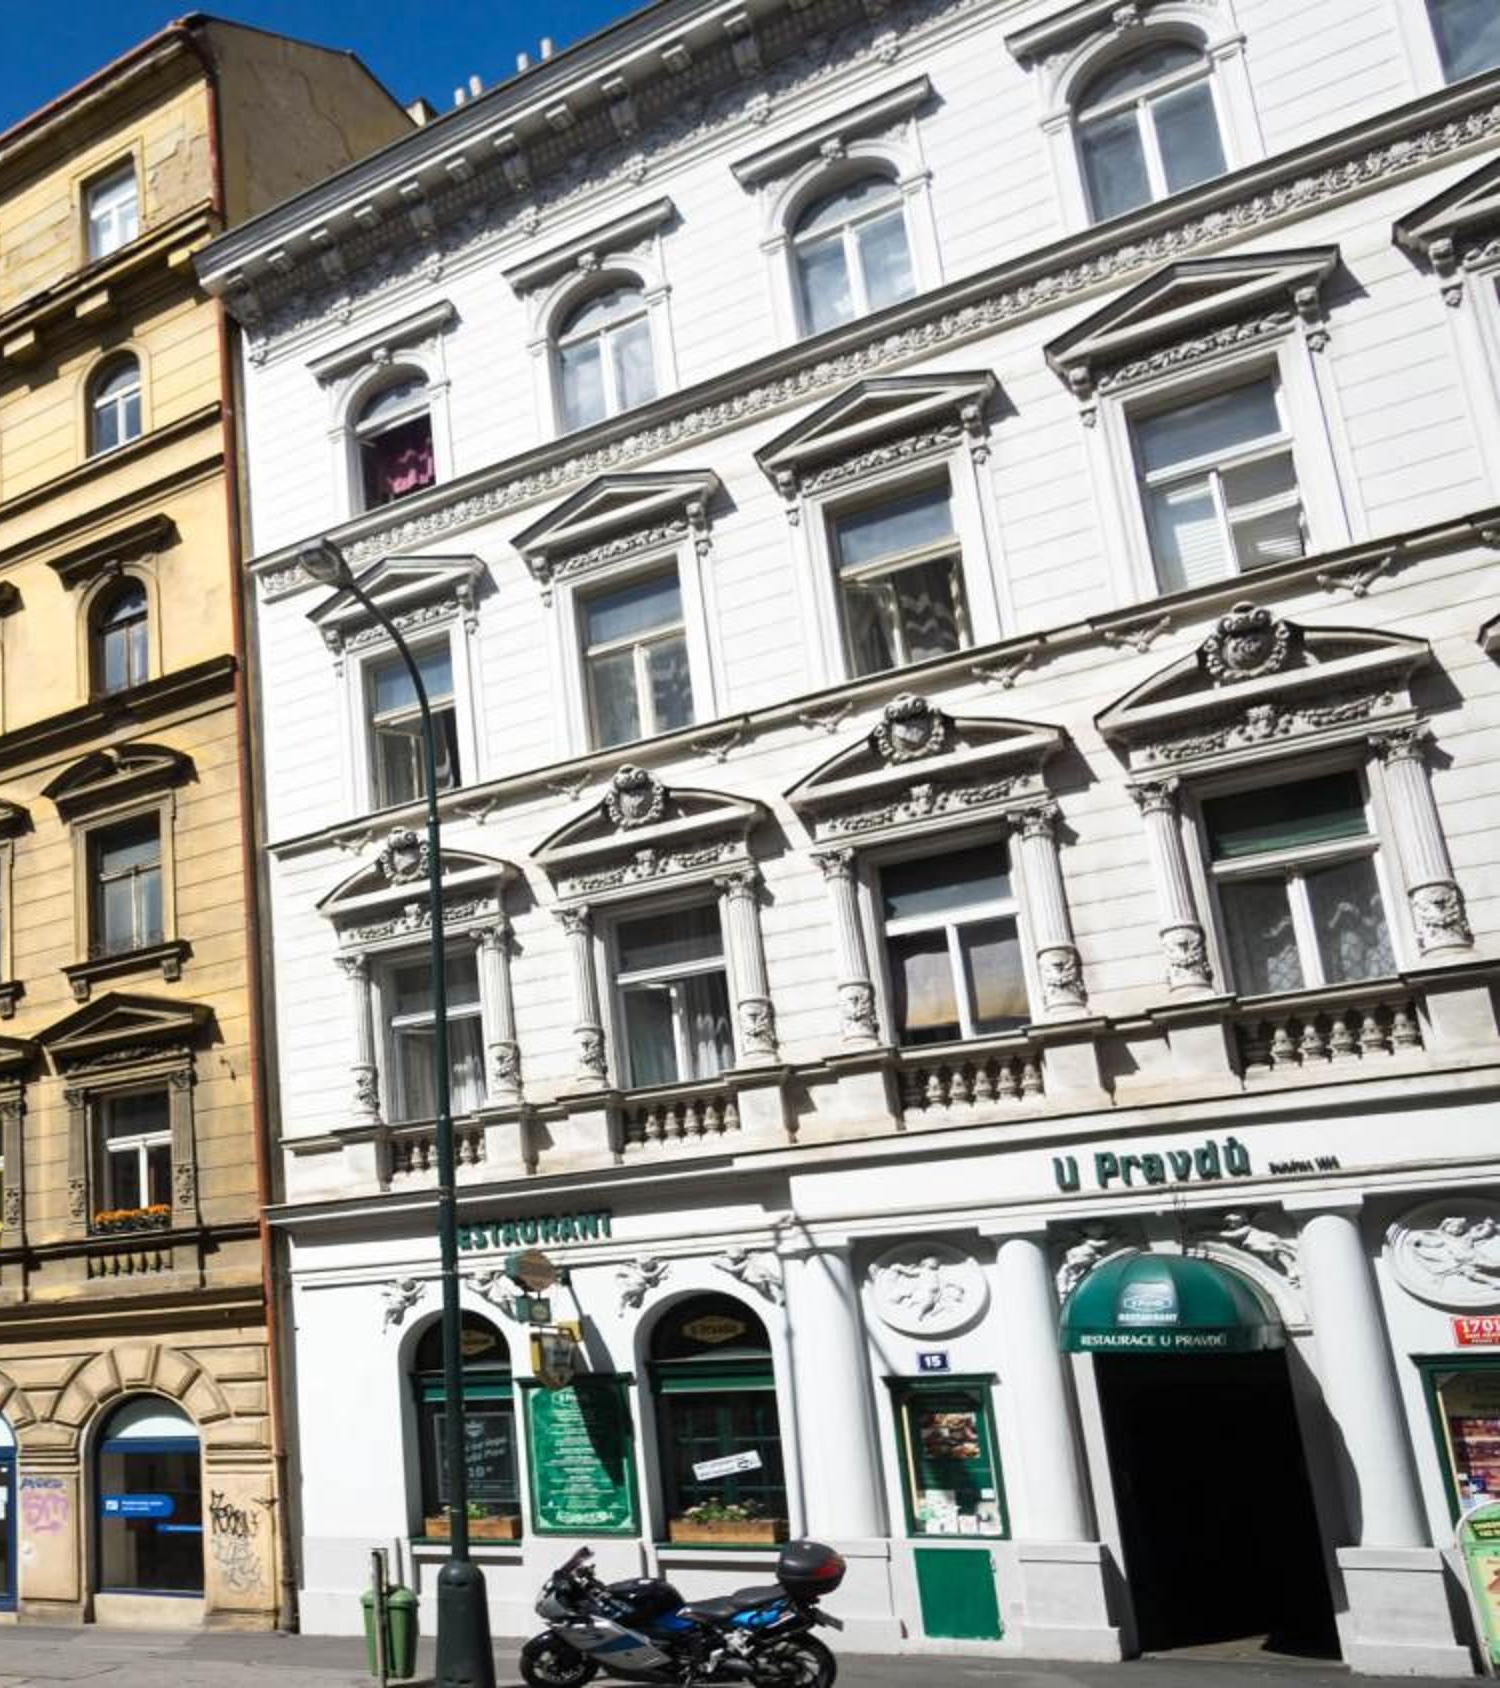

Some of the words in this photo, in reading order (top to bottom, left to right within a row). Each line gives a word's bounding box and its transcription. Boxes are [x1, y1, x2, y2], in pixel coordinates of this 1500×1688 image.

[1094, 1137, 1252, 1188] Pravdů
[456, 1210, 613, 1251] ESTAURANT
[1080, 1334, 1157, 1347] RESTAURACE
[1160, 1334, 1171, 1347] U
[923, 1354, 942, 1368] 15
